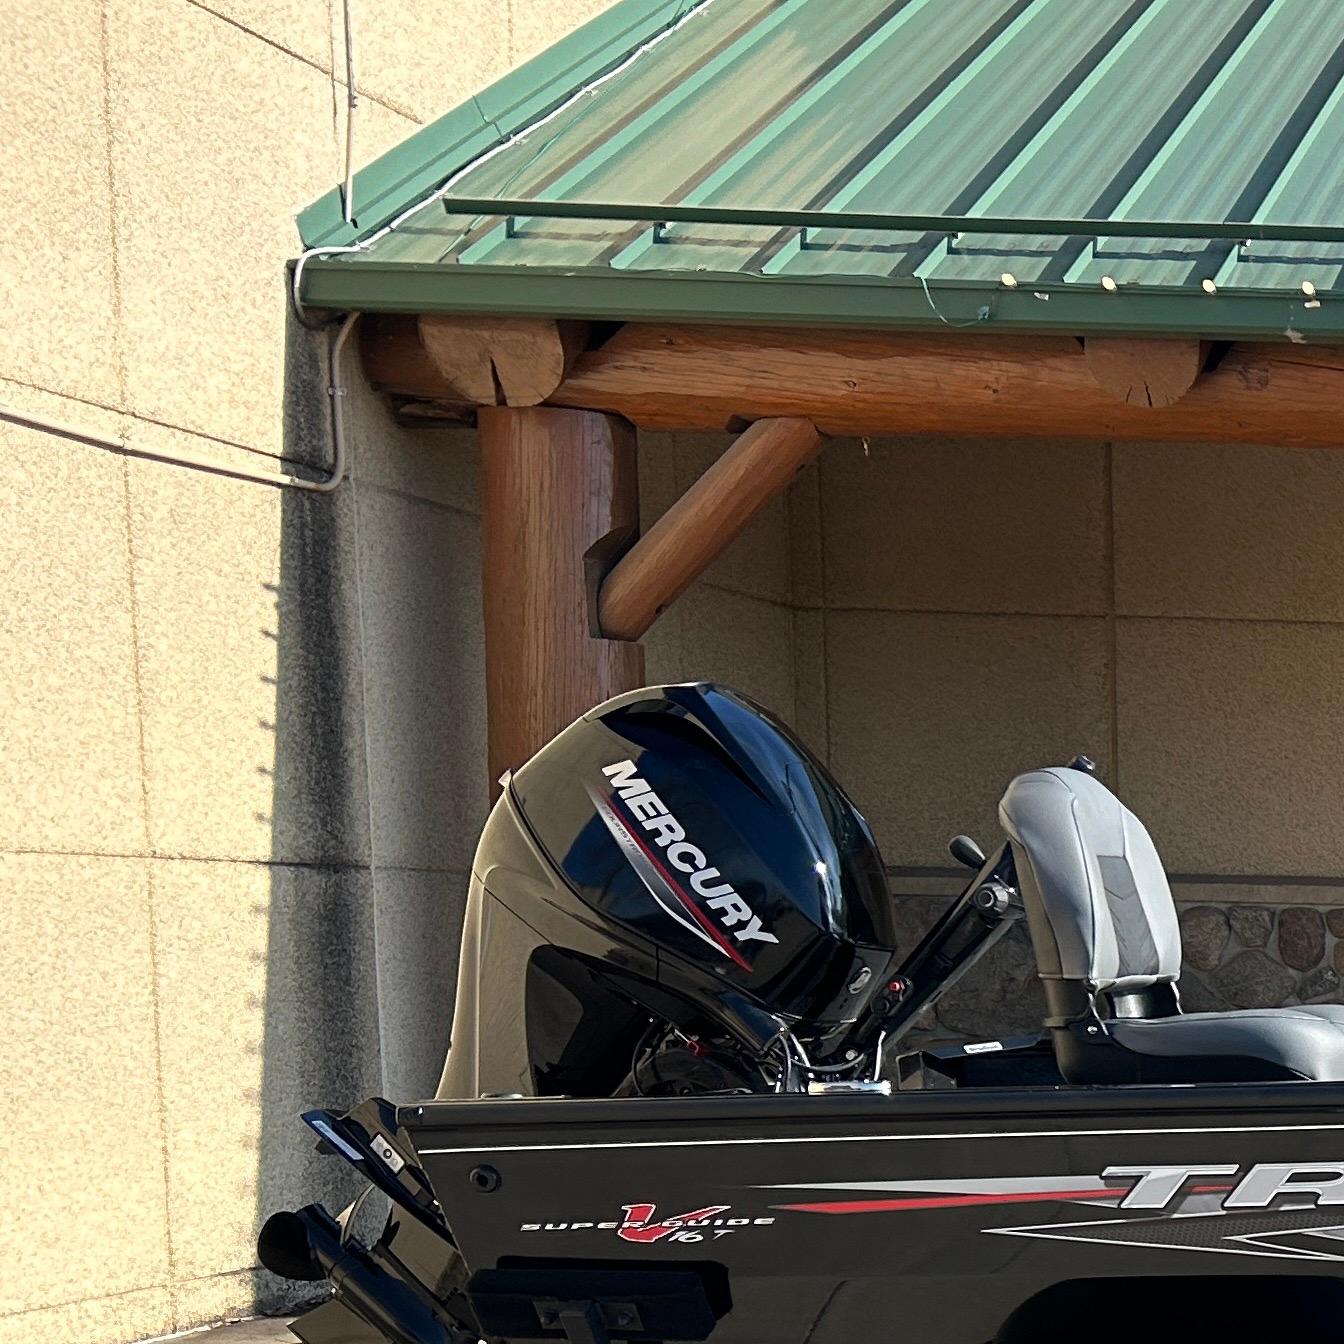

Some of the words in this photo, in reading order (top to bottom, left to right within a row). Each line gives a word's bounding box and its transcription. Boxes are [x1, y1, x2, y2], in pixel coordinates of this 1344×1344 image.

[601, 759, 780, 944] MERCURY
[520, 1220, 645, 1232] SUPER
[661, 1217, 776, 1229] GUIDE
